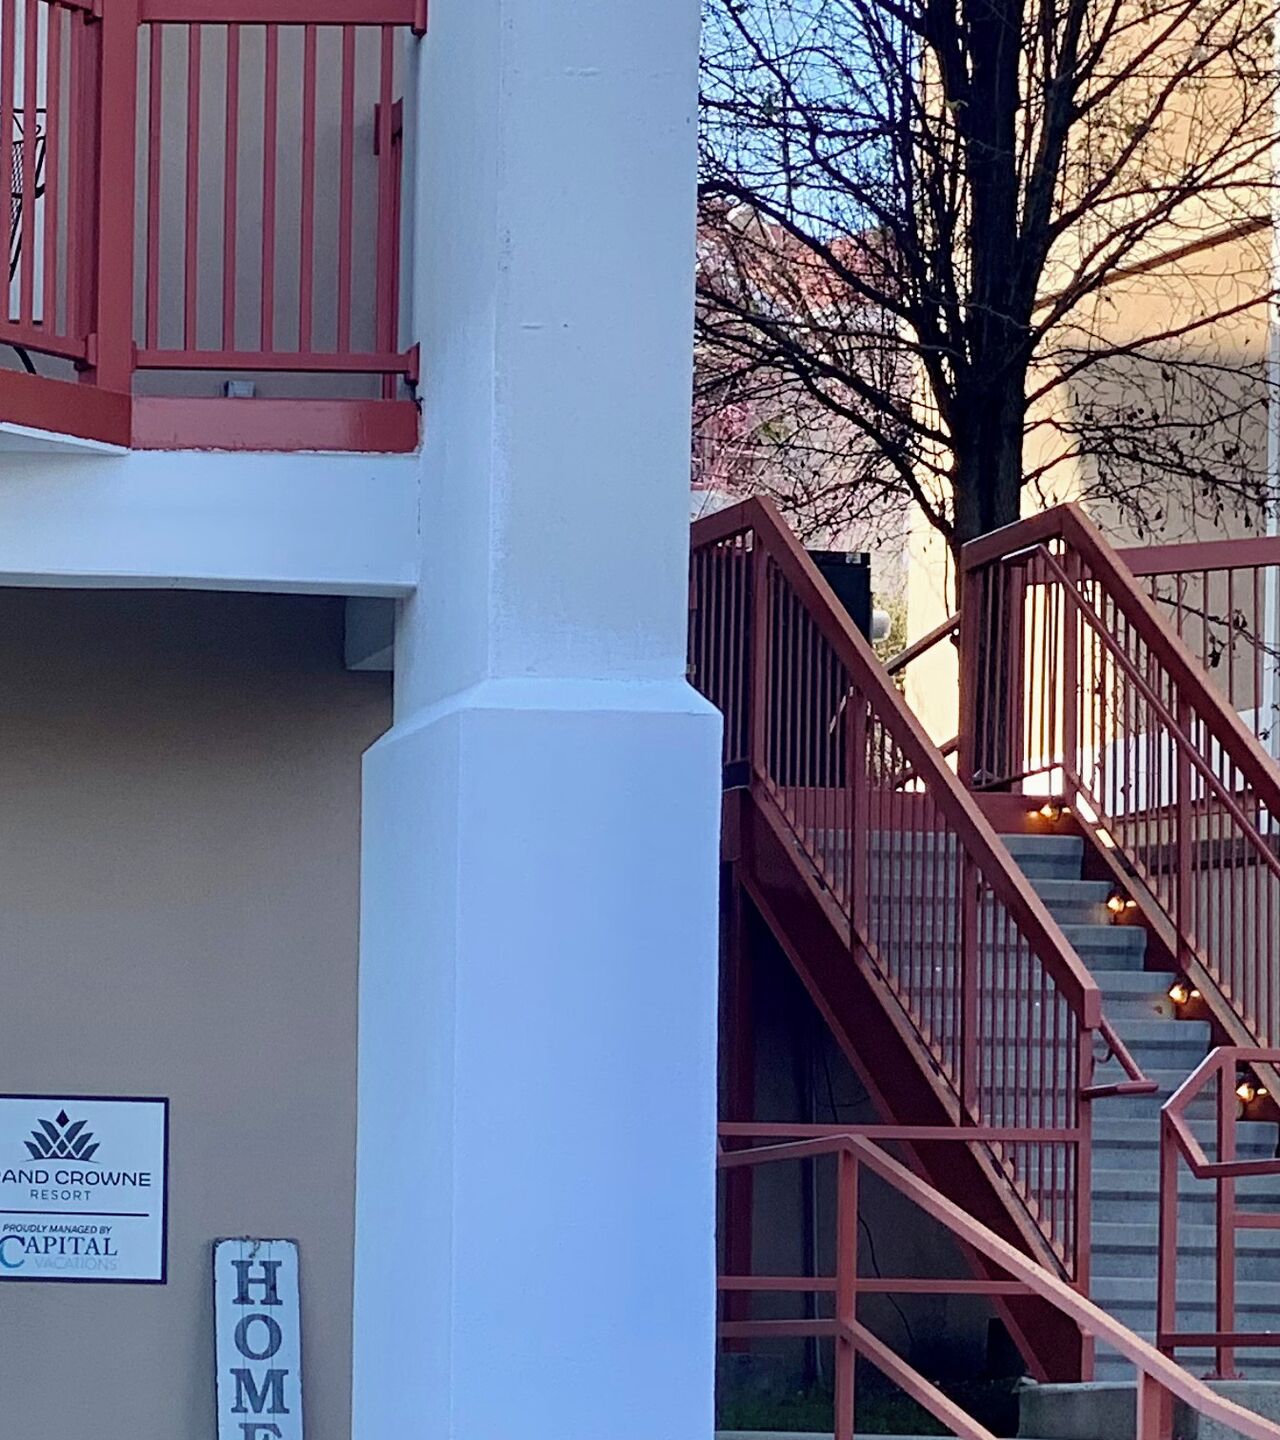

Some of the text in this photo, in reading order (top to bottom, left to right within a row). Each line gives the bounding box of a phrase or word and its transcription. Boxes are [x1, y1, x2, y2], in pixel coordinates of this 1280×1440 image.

[55, 1170, 151, 1187] CROWNE
[30, 1189, 91, 1201] RESORT
[2, 1223, 112, 1235] PROUDLY MANAGED BY
[34, 1257, 118, 1271] VACATIONS
